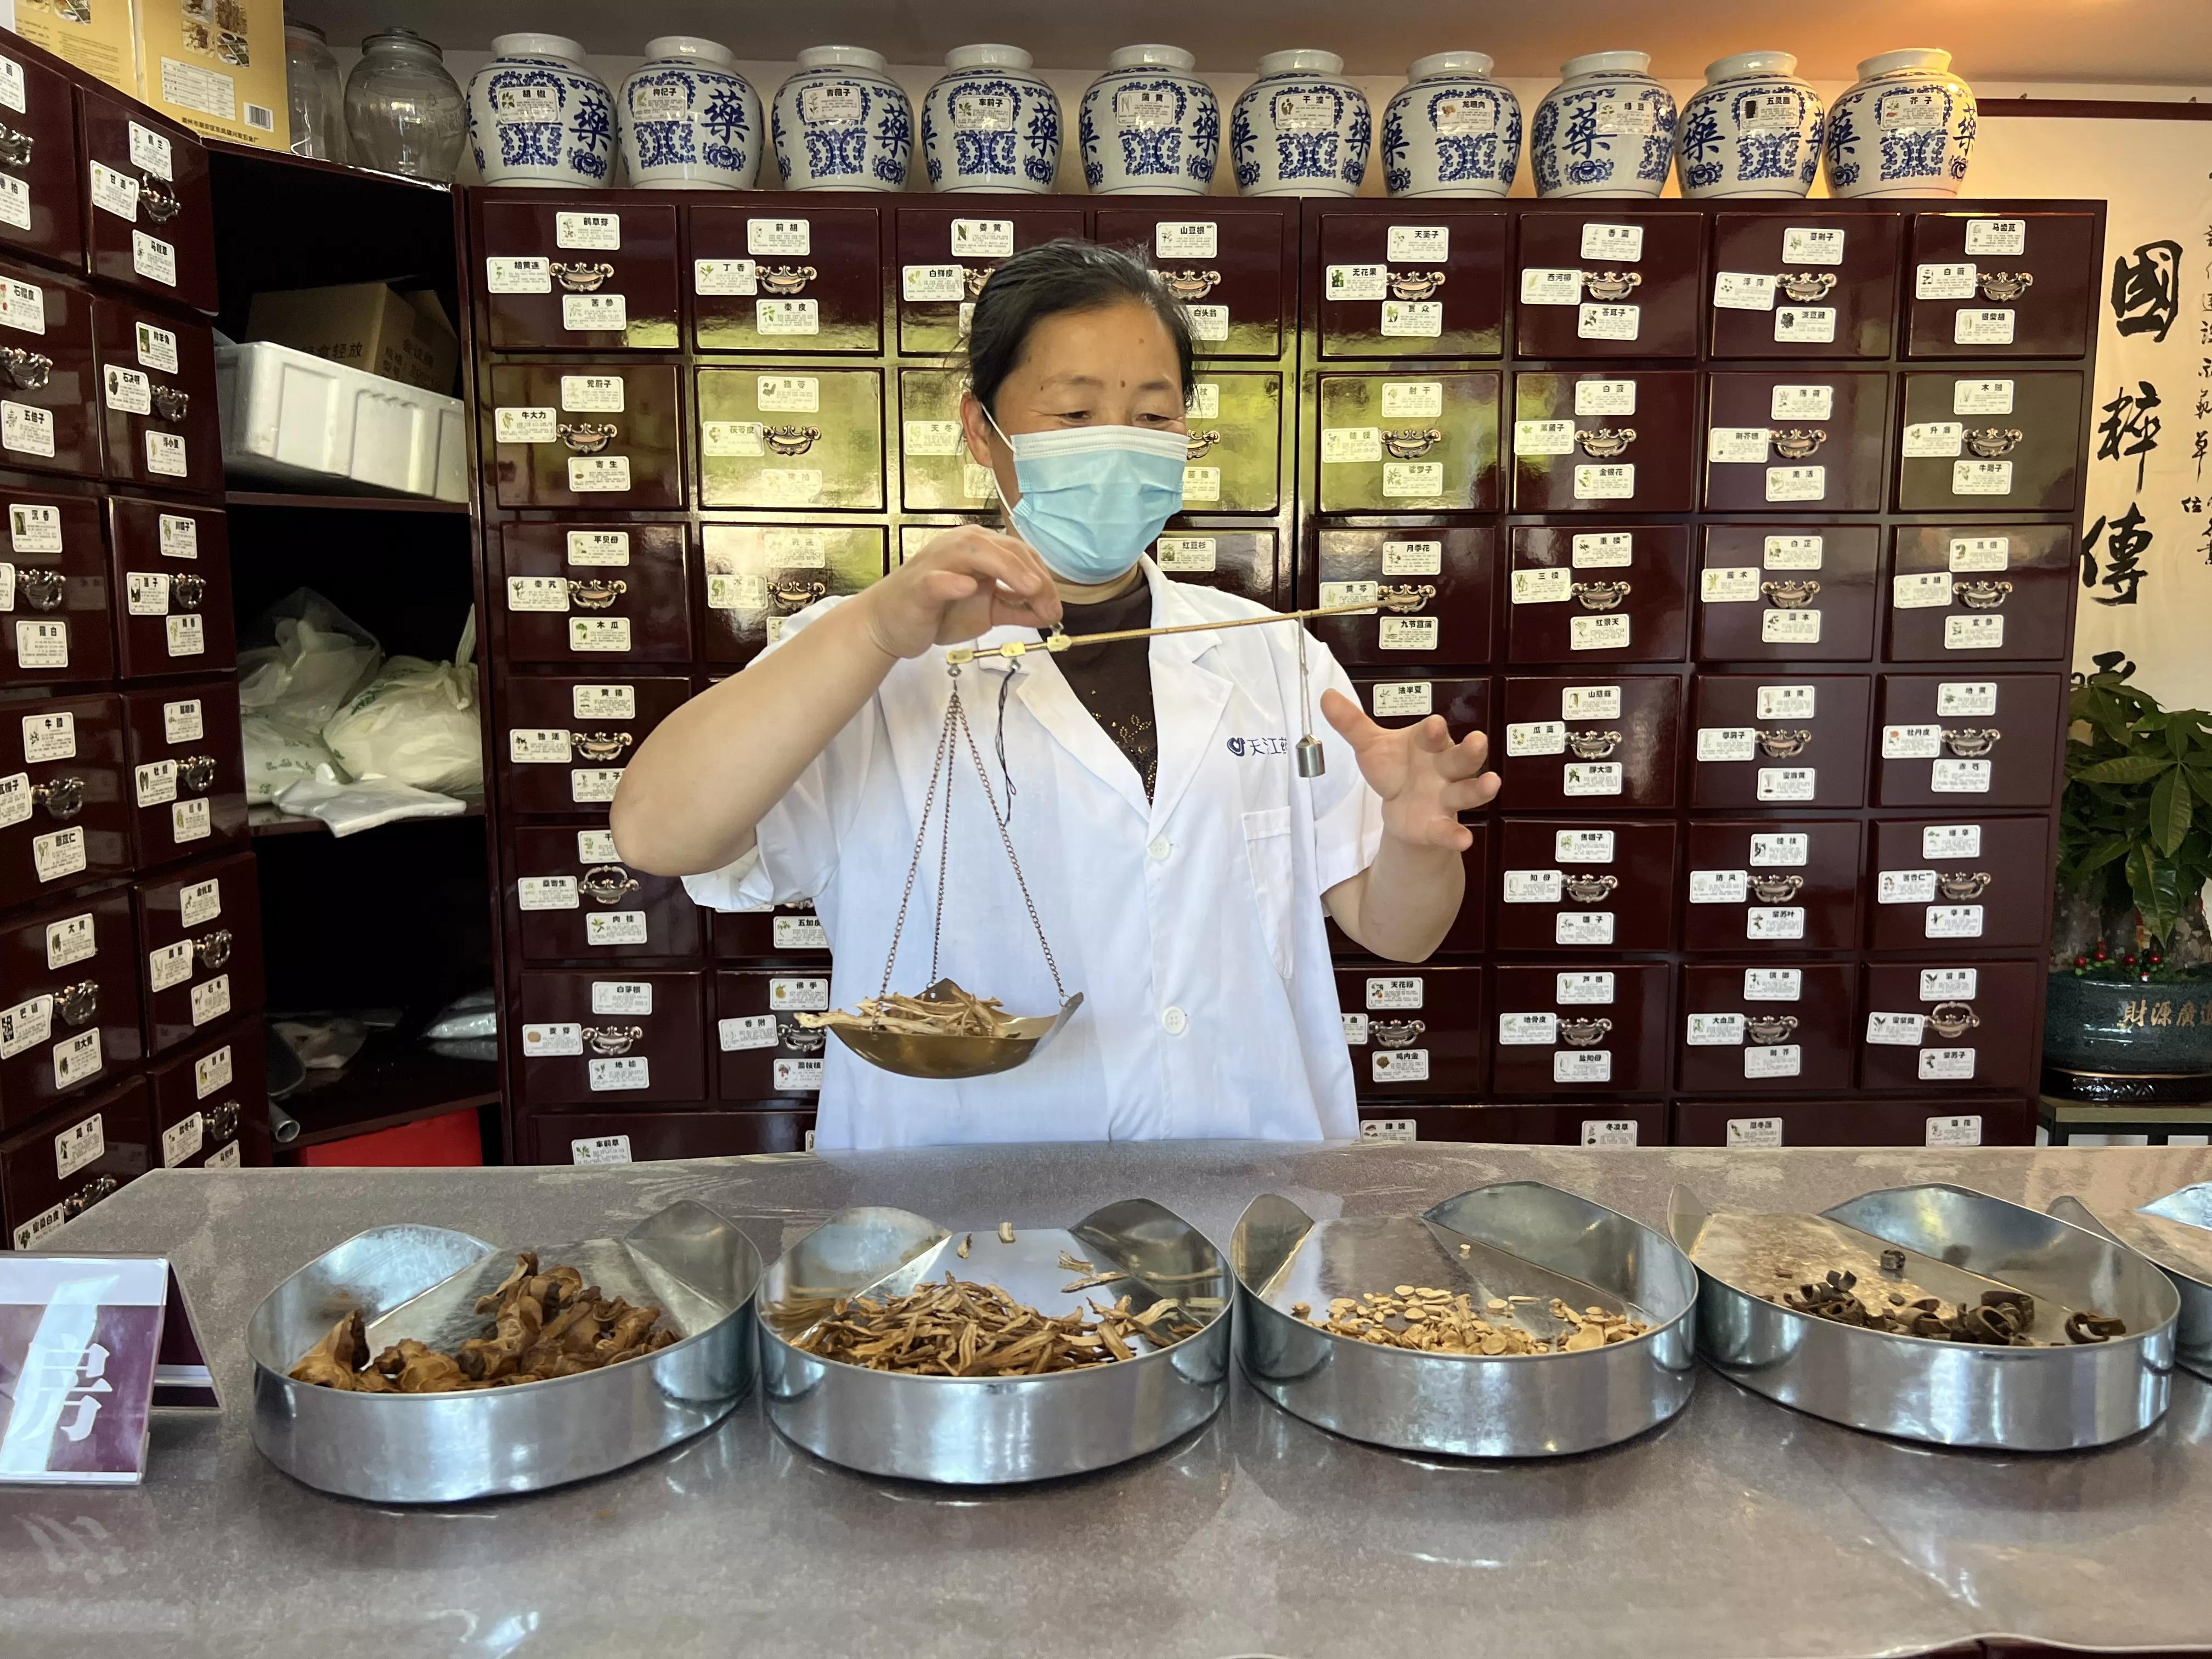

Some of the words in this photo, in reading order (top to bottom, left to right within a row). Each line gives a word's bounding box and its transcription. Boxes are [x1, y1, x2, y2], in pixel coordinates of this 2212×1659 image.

[653, 88, 676, 96] 枸杞子
[979, 98, 1003, 107] 车前子
[776, 223, 797, 232] 前胡
[1993, 223, 2016, 232] 马齿苋
[515, 261, 539, 269] 胡黄连
[929, 269, 953, 277] 白鲜皮
[785, 303, 806, 311] 秦皮
[1602, 308, 1625, 317] 苍耳子
[25, 410, 44, 424] 五倍子
